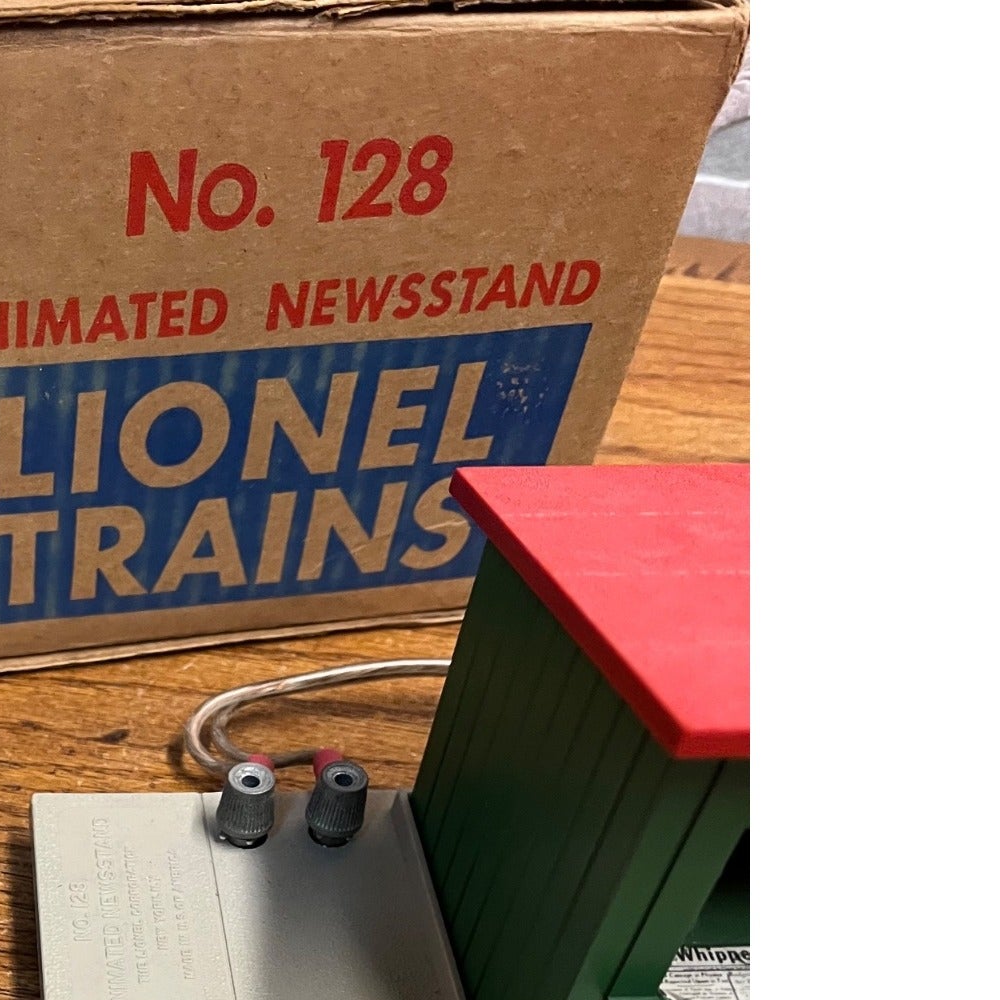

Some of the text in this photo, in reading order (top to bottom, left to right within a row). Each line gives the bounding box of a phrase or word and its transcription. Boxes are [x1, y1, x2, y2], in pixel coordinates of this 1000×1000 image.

[126, 135, 454, 237] No. 128
[265, 260, 601, 331] NEWSSTAND
[68, 880, 89, 909] 128
[91, 816, 121, 919] NEWSSTAND
